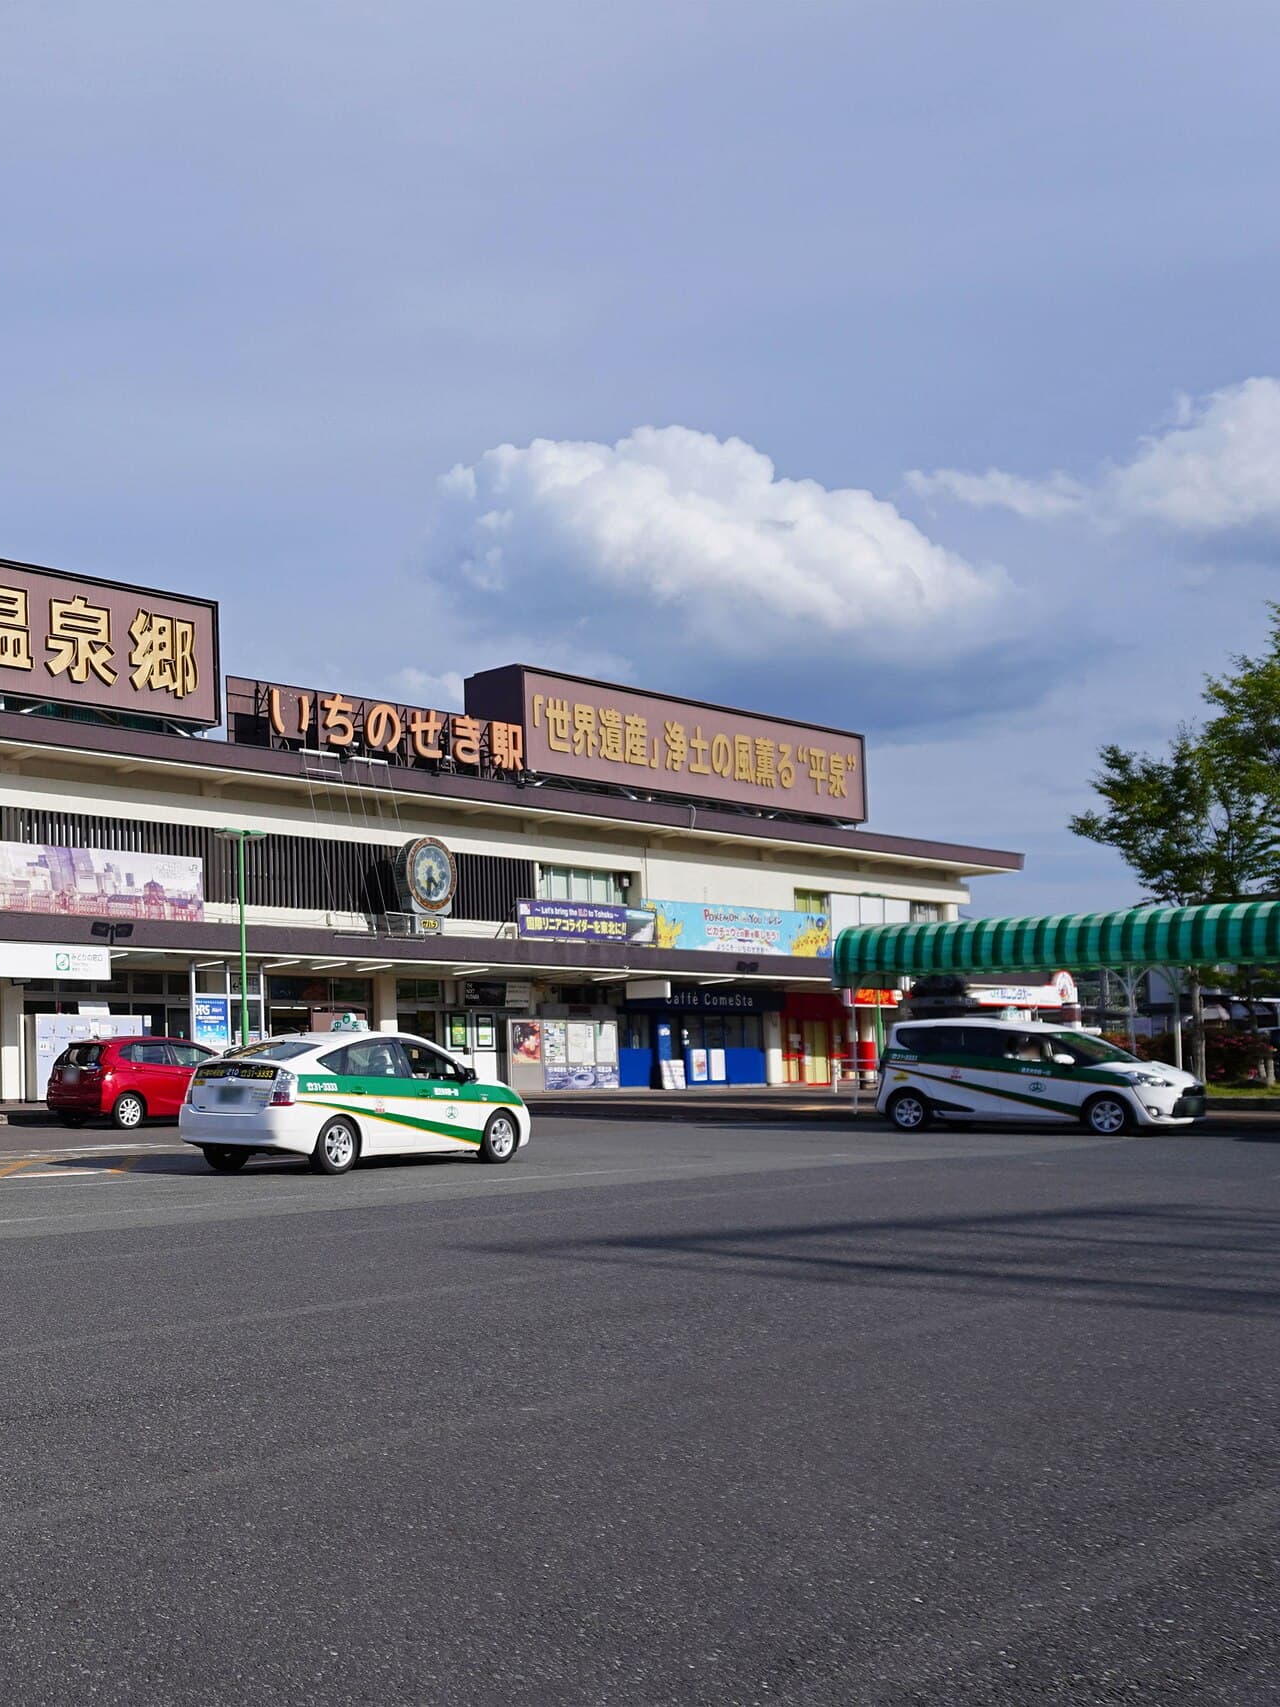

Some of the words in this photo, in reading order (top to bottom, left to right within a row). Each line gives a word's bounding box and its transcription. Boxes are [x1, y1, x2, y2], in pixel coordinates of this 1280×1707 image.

[270, 686, 525, 771] いちのせき駅
[704, 993, 753, 1007] ComeSta
